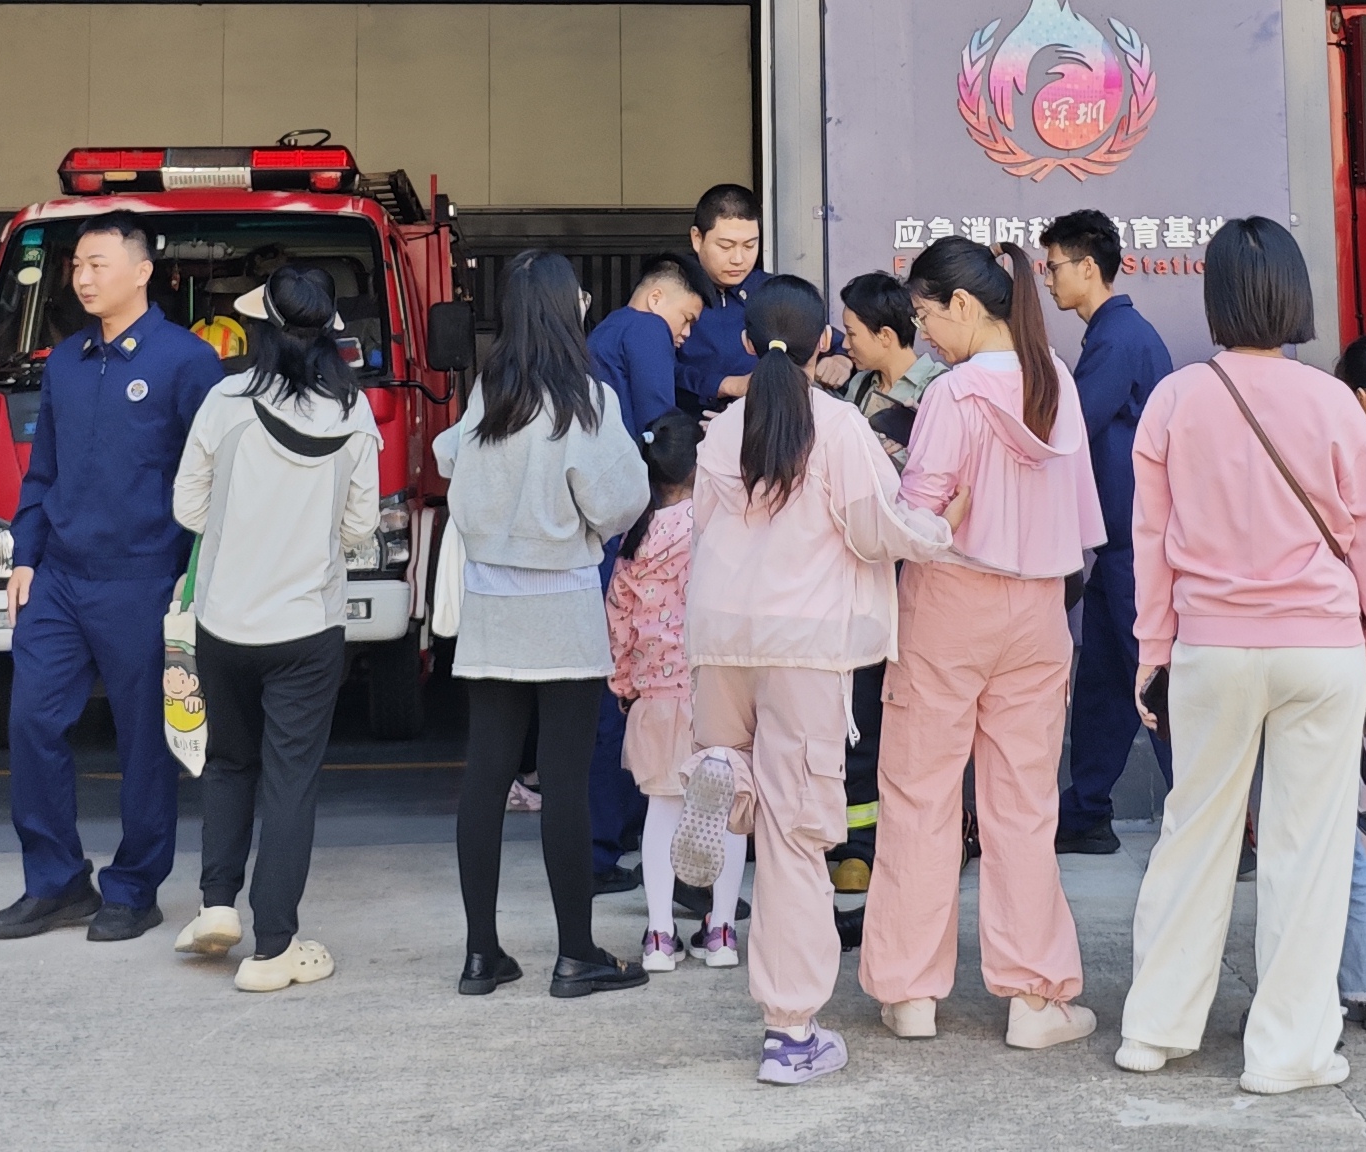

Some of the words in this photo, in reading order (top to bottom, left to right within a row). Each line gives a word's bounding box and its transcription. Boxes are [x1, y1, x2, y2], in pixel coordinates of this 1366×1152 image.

[1042, 96, 1106, 131] 深圳
[893, 215, 1226, 250] 应急消防科教育基地
[1122, 253, 1206, 276] Statio
